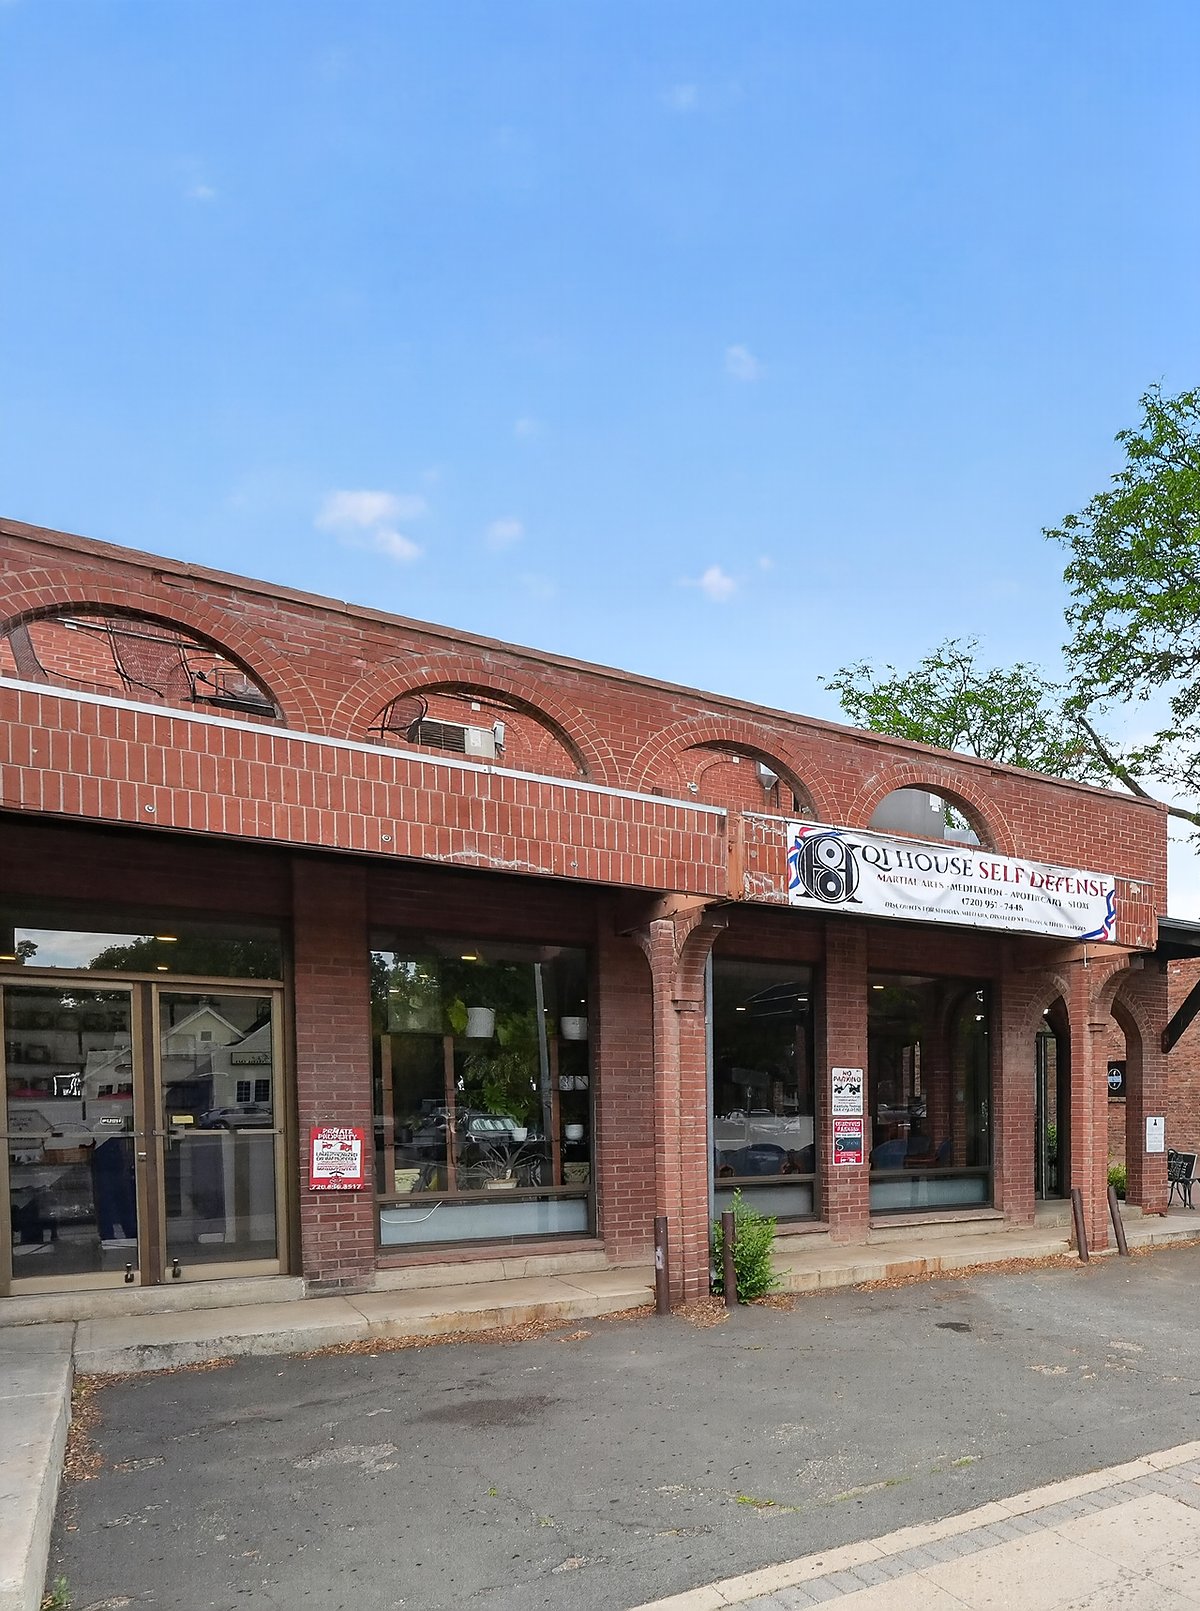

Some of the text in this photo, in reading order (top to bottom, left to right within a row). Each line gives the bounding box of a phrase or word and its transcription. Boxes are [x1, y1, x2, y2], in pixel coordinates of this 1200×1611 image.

[861, 844, 1108, 897] QI HOUSE SELF DEFENSE
[877, 874, 917, 885] MARTIAL
[921, 880, 944, 888] ARTS
[961, 897, 983, 907] (720)
